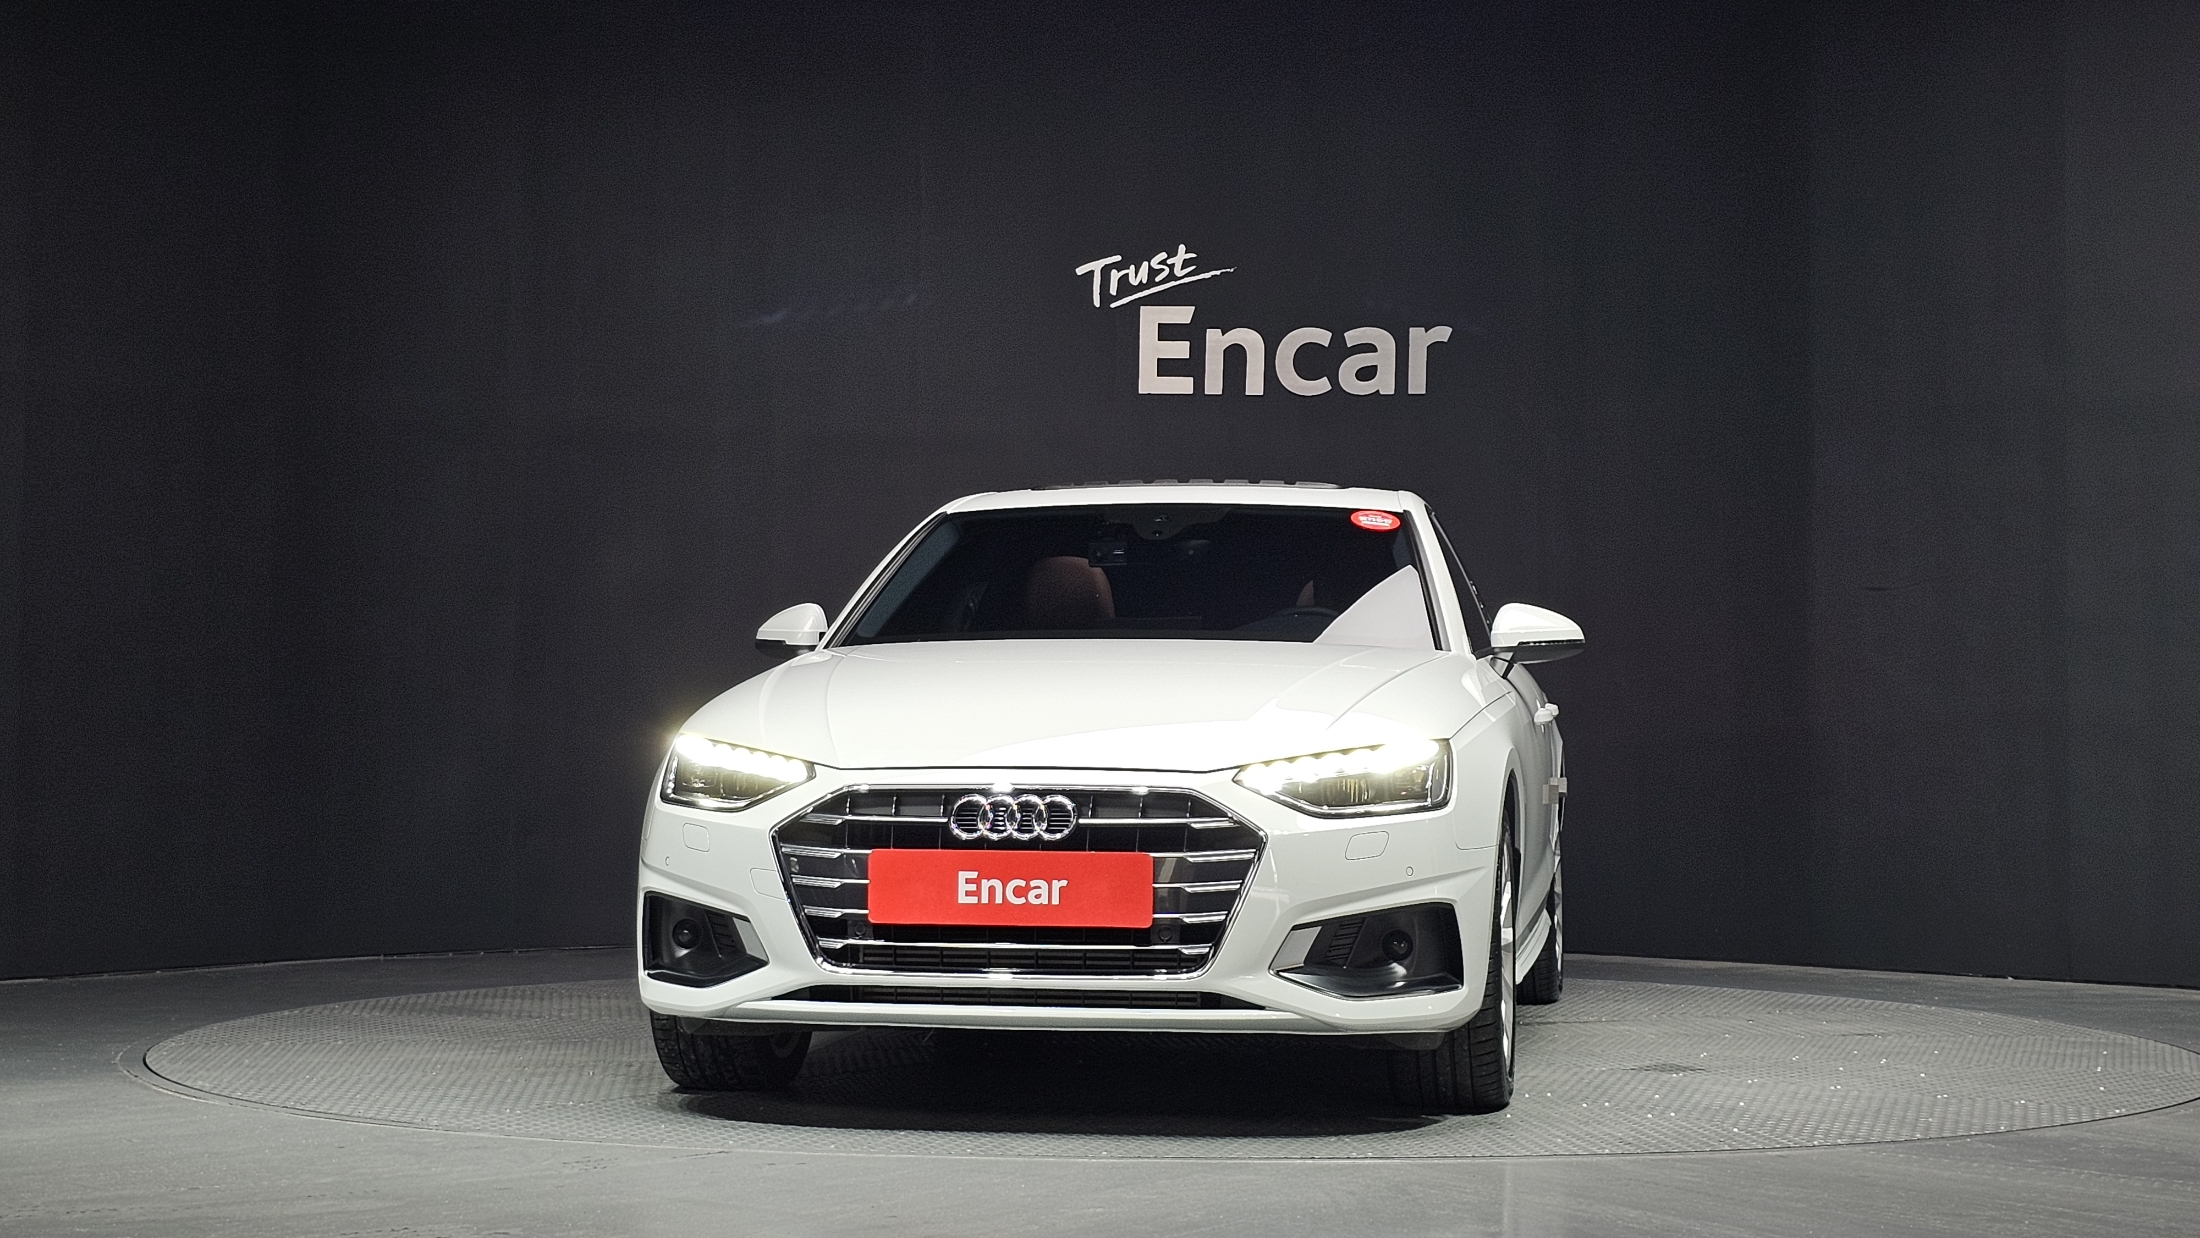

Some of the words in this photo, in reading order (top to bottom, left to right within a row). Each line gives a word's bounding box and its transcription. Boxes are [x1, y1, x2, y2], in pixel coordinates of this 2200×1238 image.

[1075, 243, 1198, 308] Trust
[1138, 305, 1453, 396] Encar
[957, 870, 1068, 905] Encar
